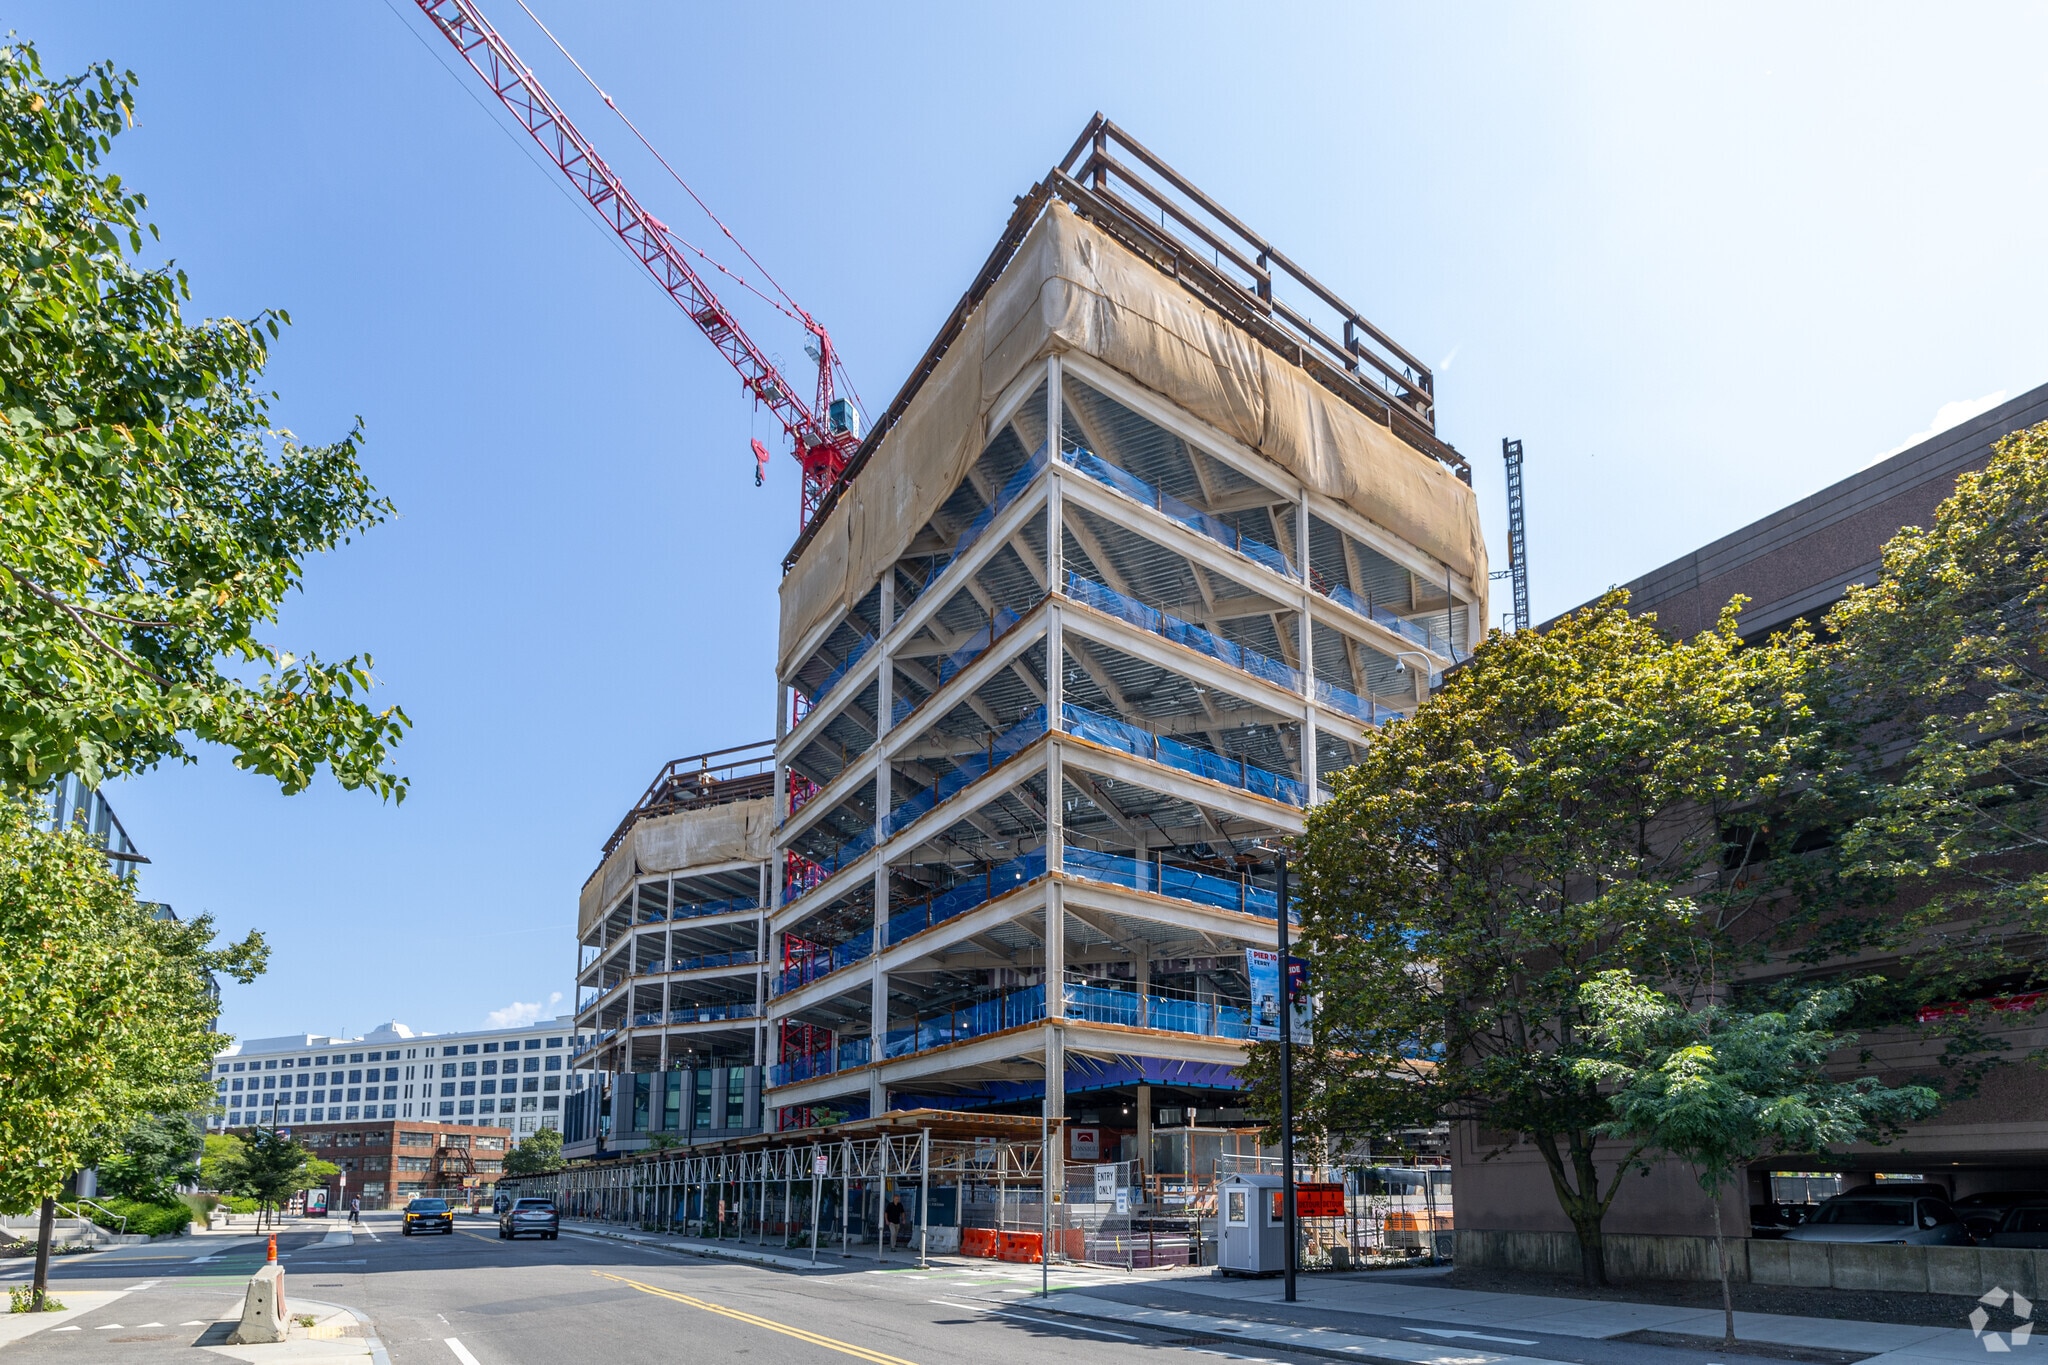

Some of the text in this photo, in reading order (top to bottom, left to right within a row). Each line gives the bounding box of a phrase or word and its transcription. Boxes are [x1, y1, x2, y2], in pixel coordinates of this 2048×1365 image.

[1254, 951, 1269, 960] PIER
[1289, 965, 1301, 974] IDE
[1097, 1171, 1114, 1182] ENTRY
[1098, 1185, 1113, 1195] ONLY
